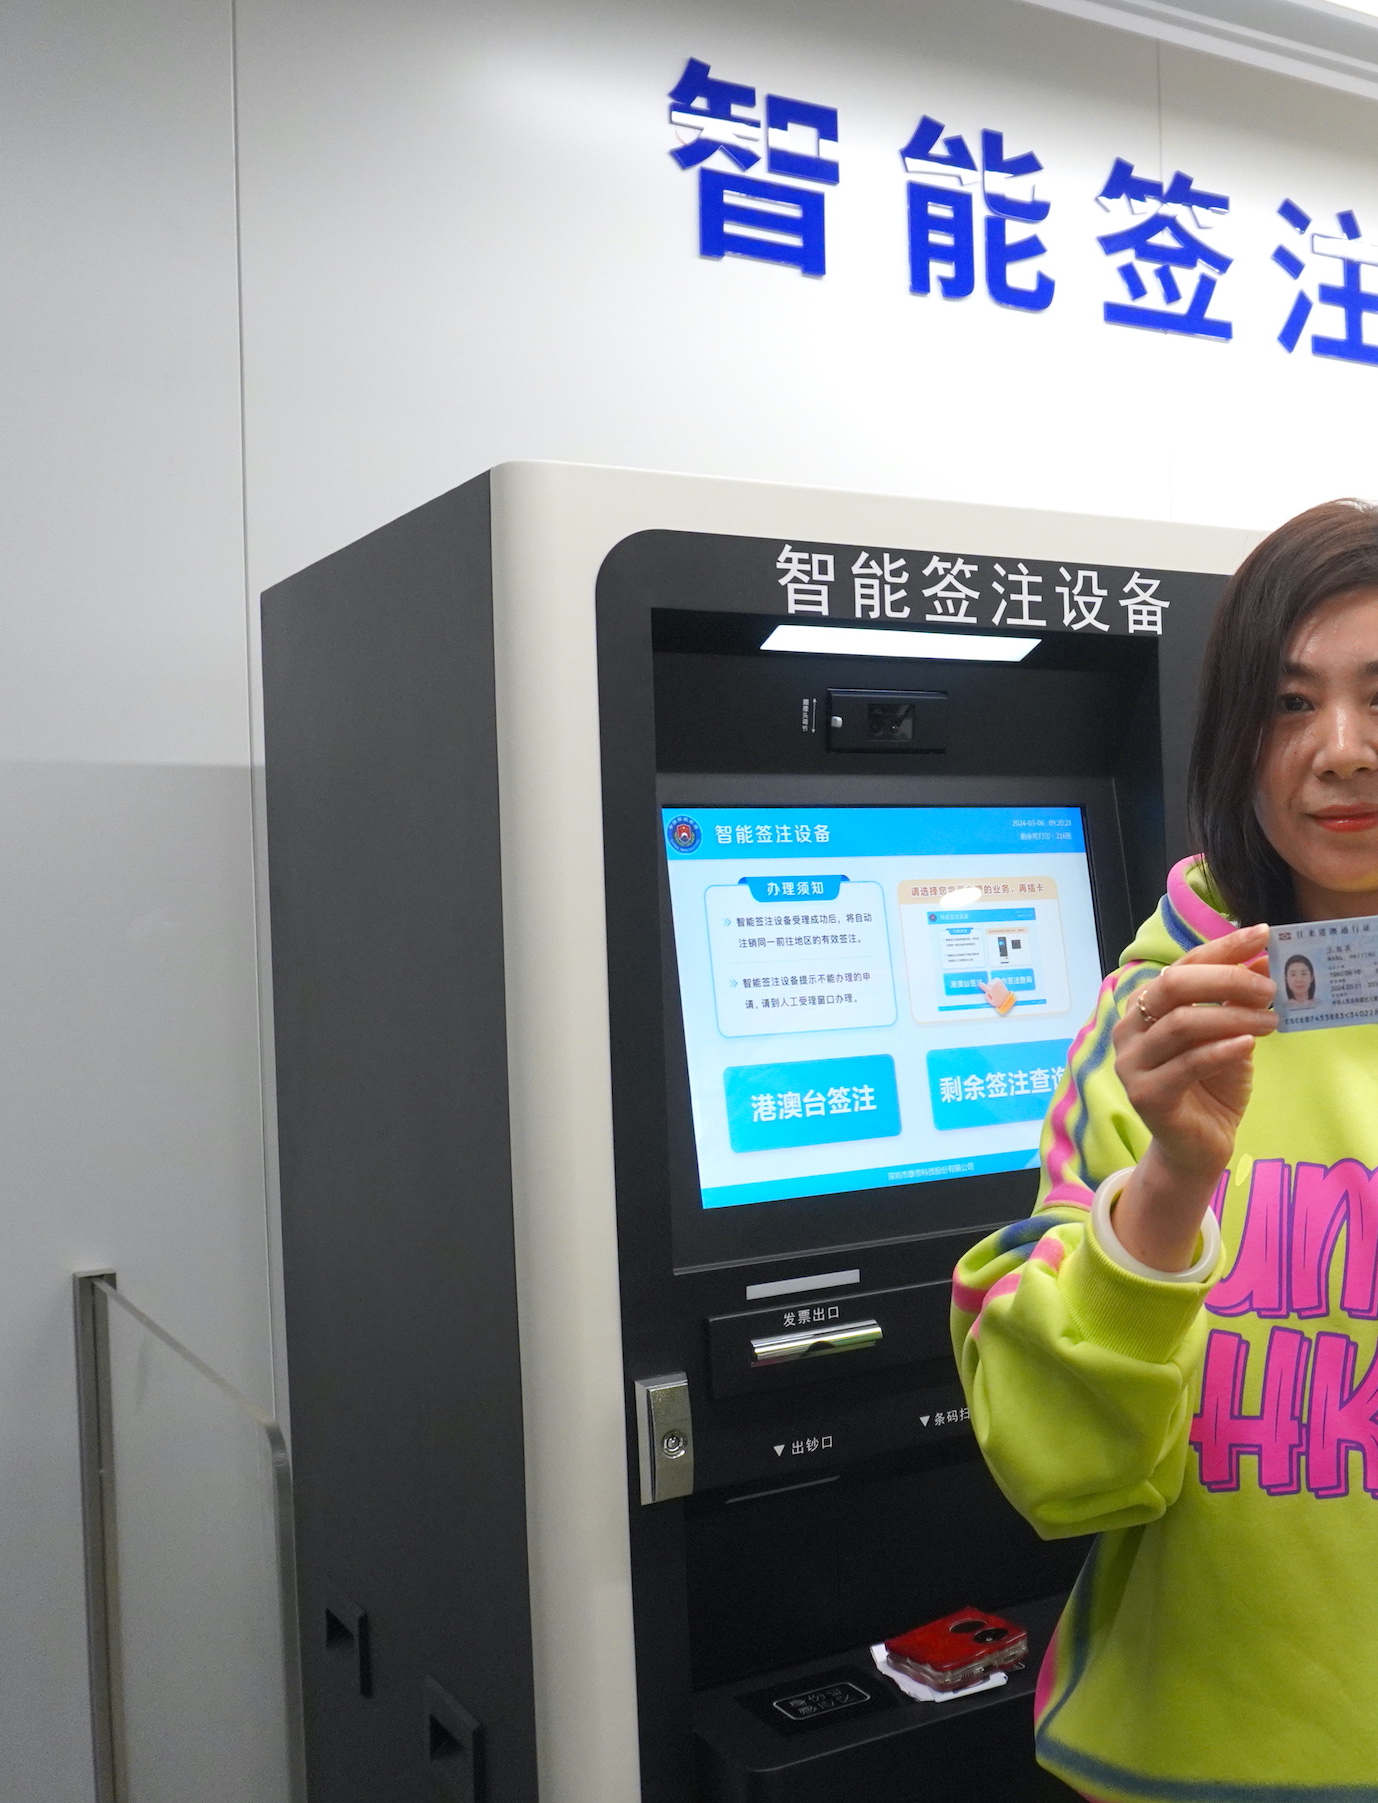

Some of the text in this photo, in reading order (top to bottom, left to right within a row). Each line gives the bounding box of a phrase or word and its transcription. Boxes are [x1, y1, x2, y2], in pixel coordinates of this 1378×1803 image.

[776, 544, 1170, 635] 智能签注设备
[715, 824, 830, 844] 智能签注设备
[767, 881, 824, 896] 办理须知
[736, 913, 872, 928] 智能签注设备受理成功后，将自动
[739, 934, 862, 949] 注销同一前往地区的有效签注。
[743, 972, 871, 989] 智能签注设备提示不能办理的申
[751, 1084, 877, 1124] 港澳台签注
[782, 1305, 840, 1328] 发票出口
[791, 1435, 834, 1456] 出钞口
